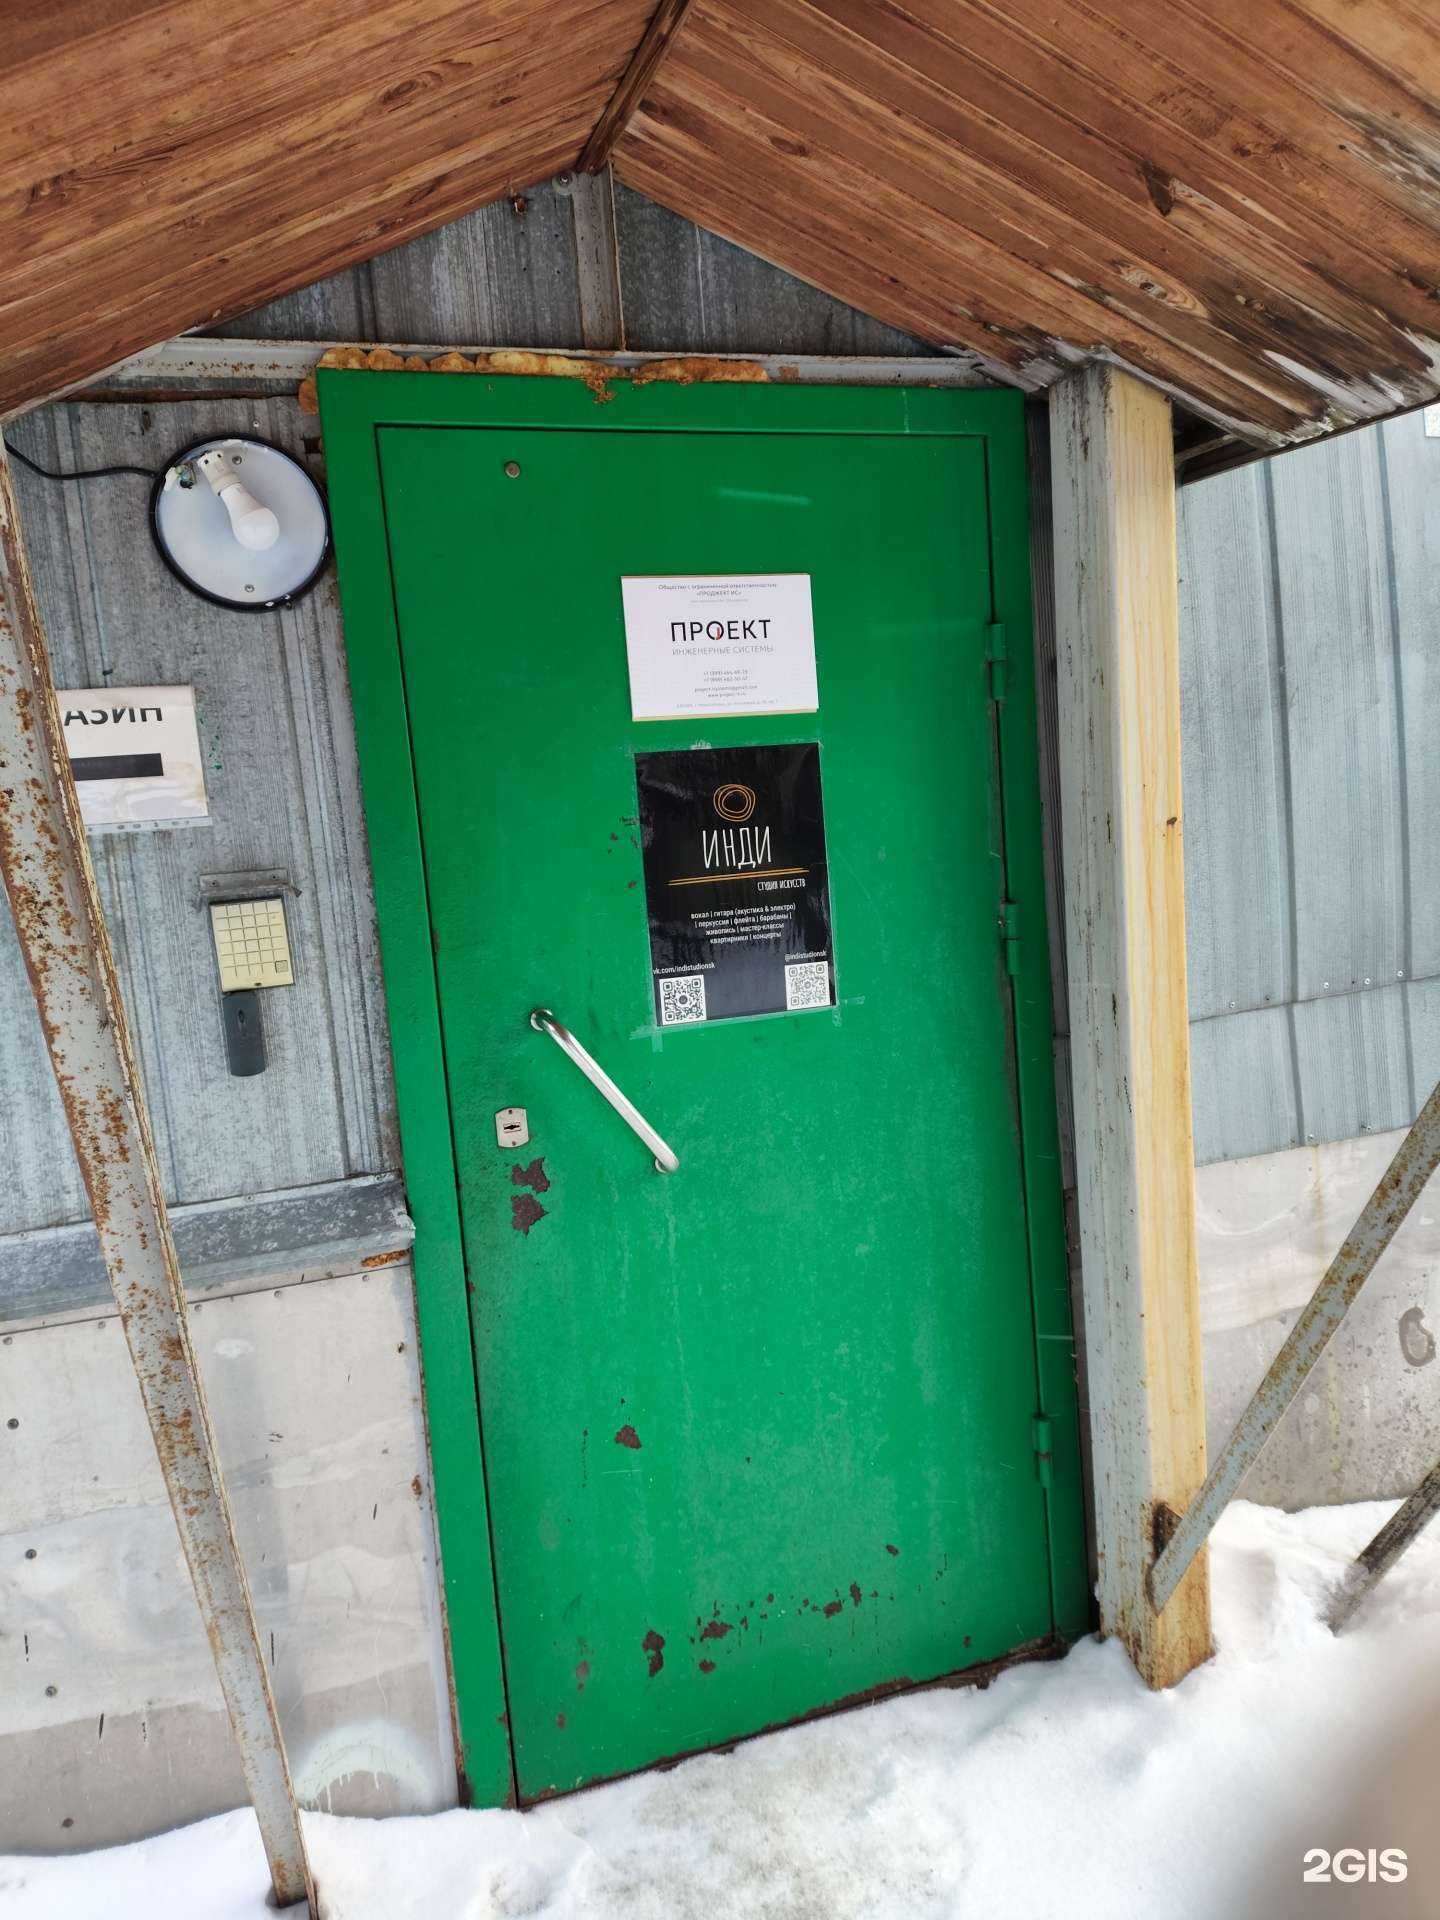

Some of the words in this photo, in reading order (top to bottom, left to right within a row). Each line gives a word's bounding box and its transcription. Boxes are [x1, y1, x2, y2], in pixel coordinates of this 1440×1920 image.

[671, 619, 771, 642] ПРОЕКТ
[672, 646, 732, 656] ИНЖЕНЕРНЫЕ
[732, 644, 774, 654] СИСТЕМЫ
[702, 826, 772, 869] ИНДИ
[757, 880, 778, 891] СТУДИЯ
[779, 878, 806, 889] ИСКУССТВ
[714, 910, 734, 918] гитара
[735, 907, 764, 916] (акустика
[698, 919, 730, 928] перкуссия
[734, 916, 756, 925] флейта
[759, 912, 788, 921] барабаны
[706, 928, 736, 936] живопись
[740, 923, 785, 932] мастер-классы
[709, 935, 749, 944] квартирники
[752, 931, 782, 940] концерты
[652, 961, 716, 974] vk.com/indistudionsk
